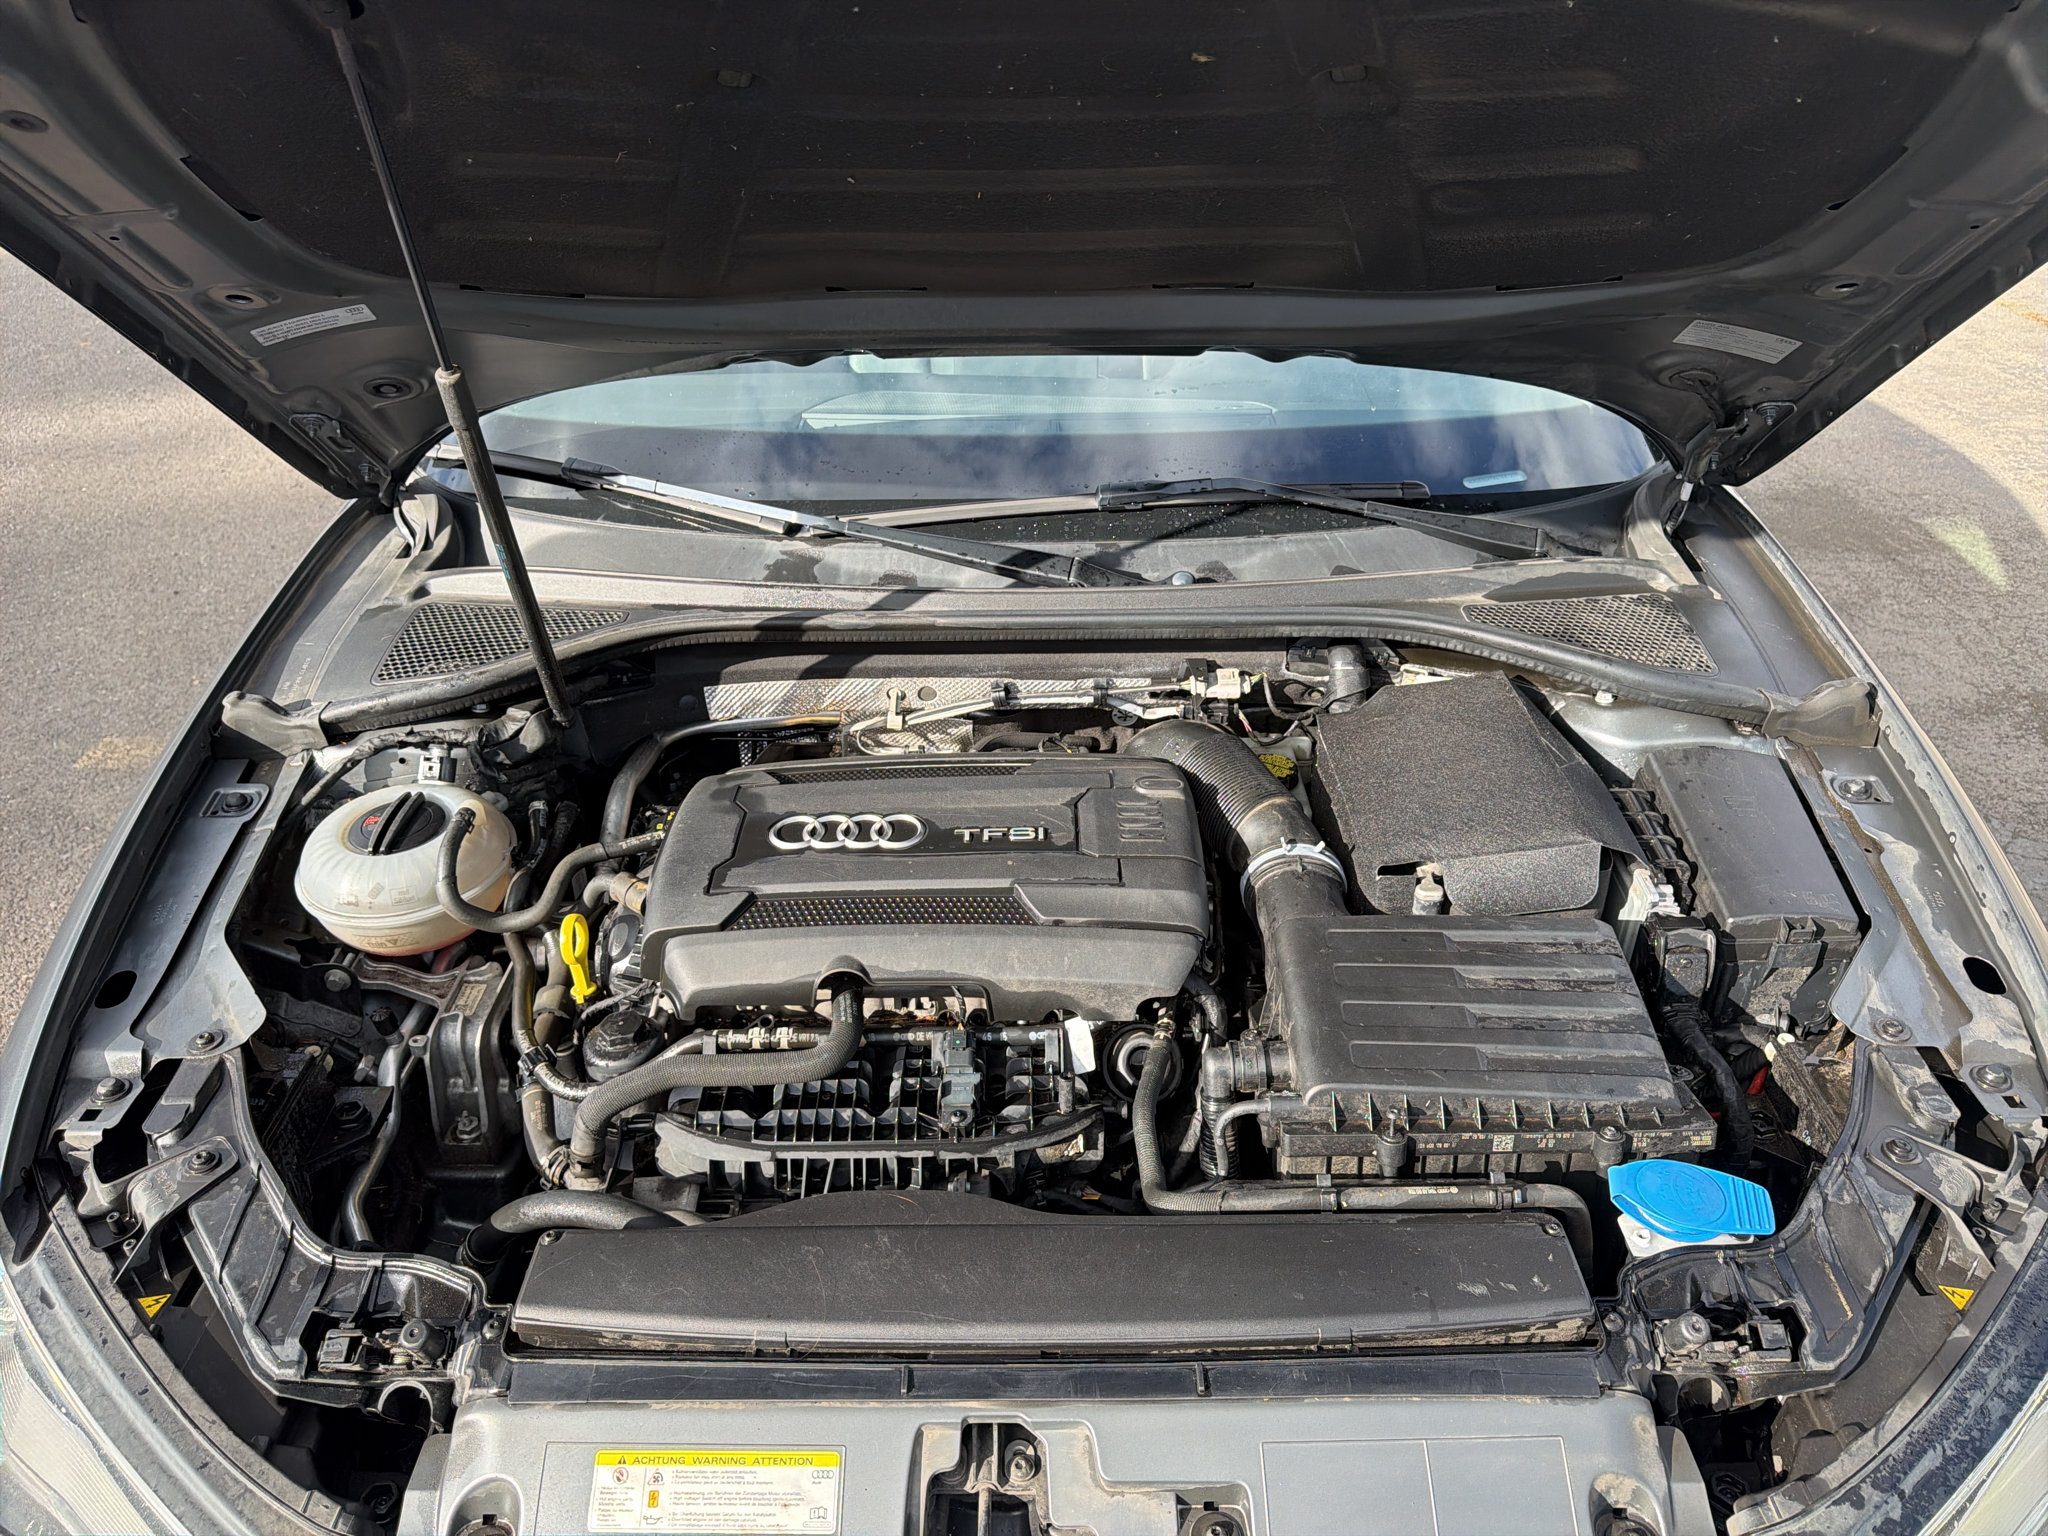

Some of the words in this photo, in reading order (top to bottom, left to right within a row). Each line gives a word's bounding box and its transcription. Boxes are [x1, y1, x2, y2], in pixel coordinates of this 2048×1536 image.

[953, 826, 1045, 844] TFSI
[632, 1456, 686, 1465] ACHTUNG
[692, 1456, 747, 1465] WARNING
[752, 1457, 814, 1466] ATTENTION
